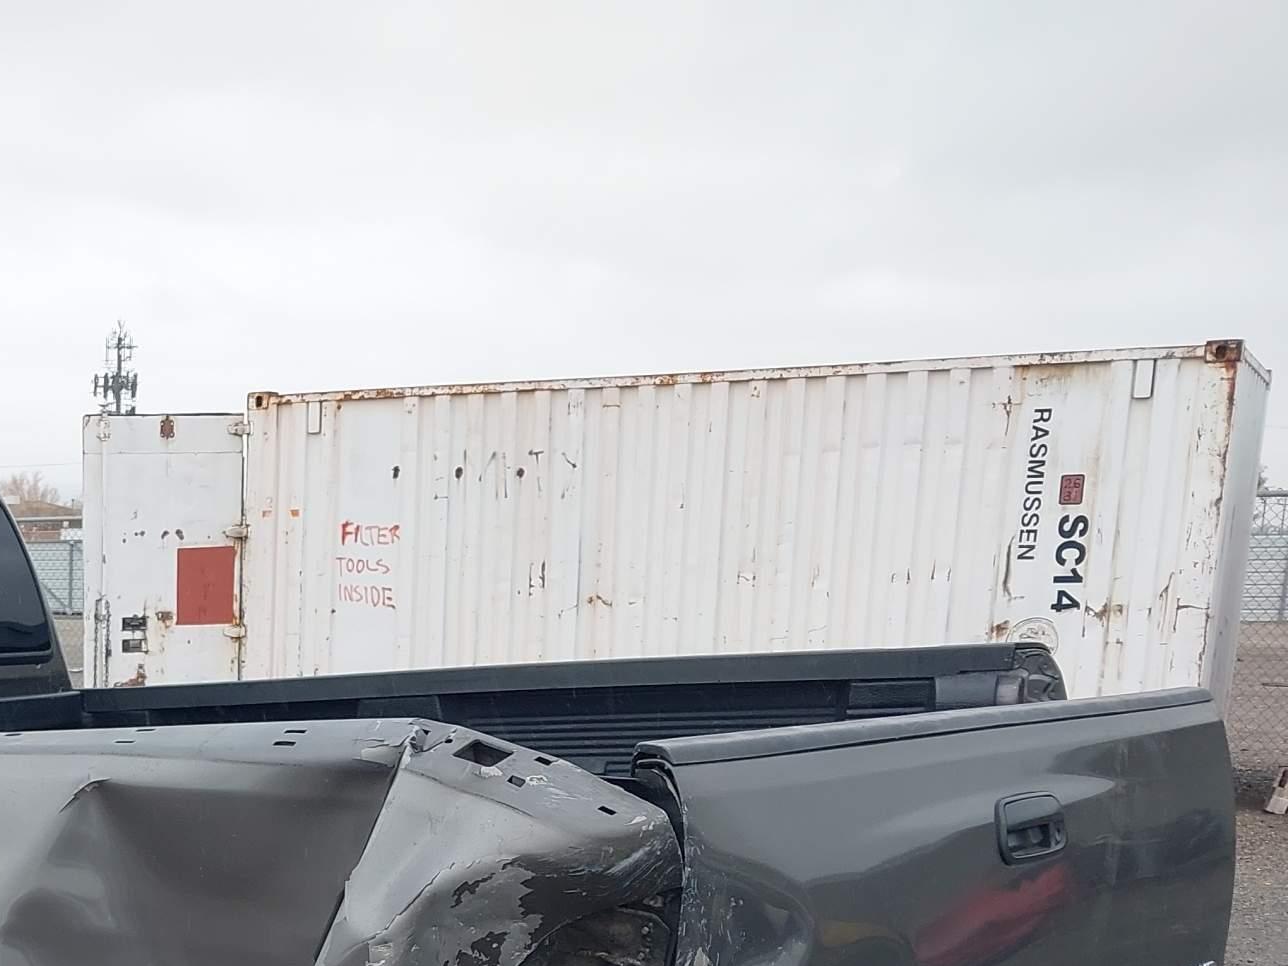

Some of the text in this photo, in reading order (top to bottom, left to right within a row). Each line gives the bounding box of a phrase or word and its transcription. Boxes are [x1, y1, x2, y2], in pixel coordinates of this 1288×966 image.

[1016, 407, 1053, 560] RASMUSSEN
[335, 556, 391, 577] TOOLS
[1050, 513, 1089, 613] SC14
[338, 583, 397, 610] INSIDE
